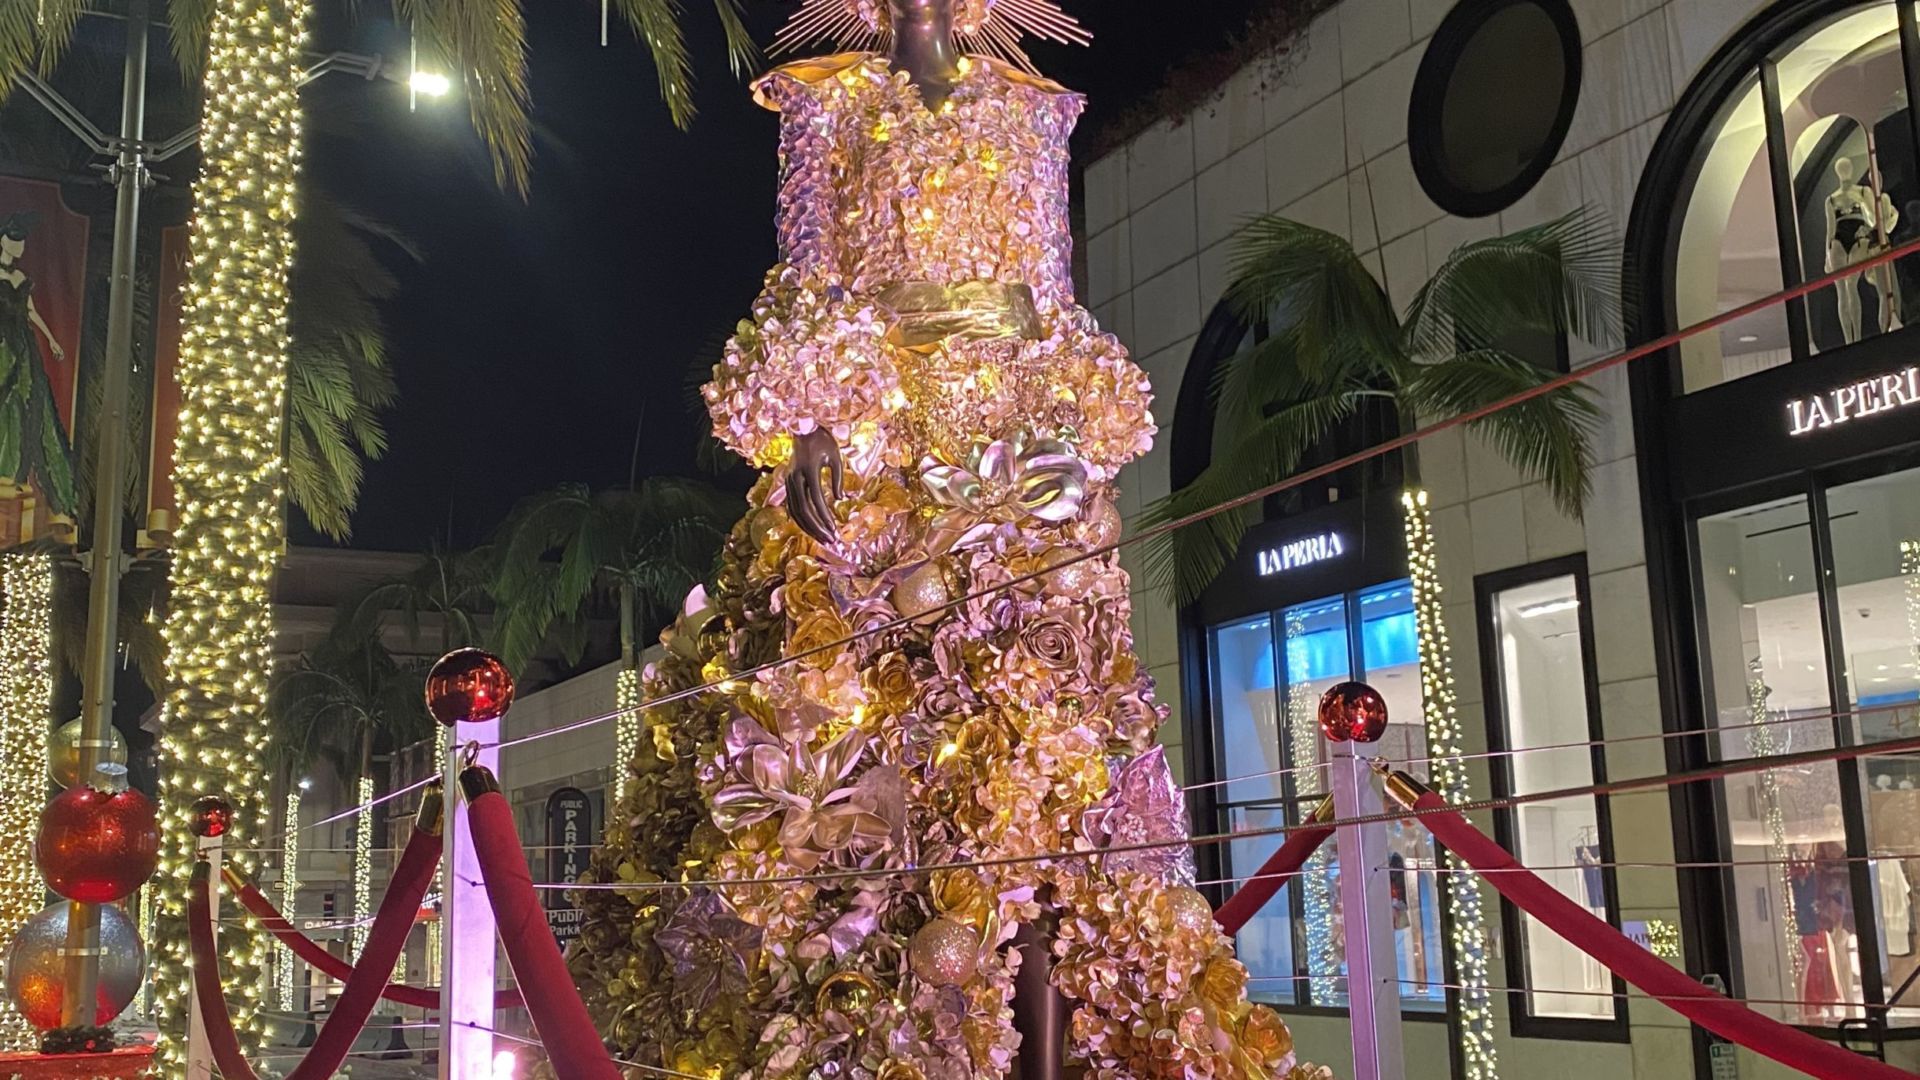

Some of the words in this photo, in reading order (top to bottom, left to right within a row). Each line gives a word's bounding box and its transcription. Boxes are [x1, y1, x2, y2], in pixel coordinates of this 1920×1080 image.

[1830, 367, 1920, 423] PERL
[560, 799, 583, 808] PUBLIC
[563, 810, 577, 885] PARKING
[549, 910, 582, 923] Publ
[550, 924, 580, 936] Park
